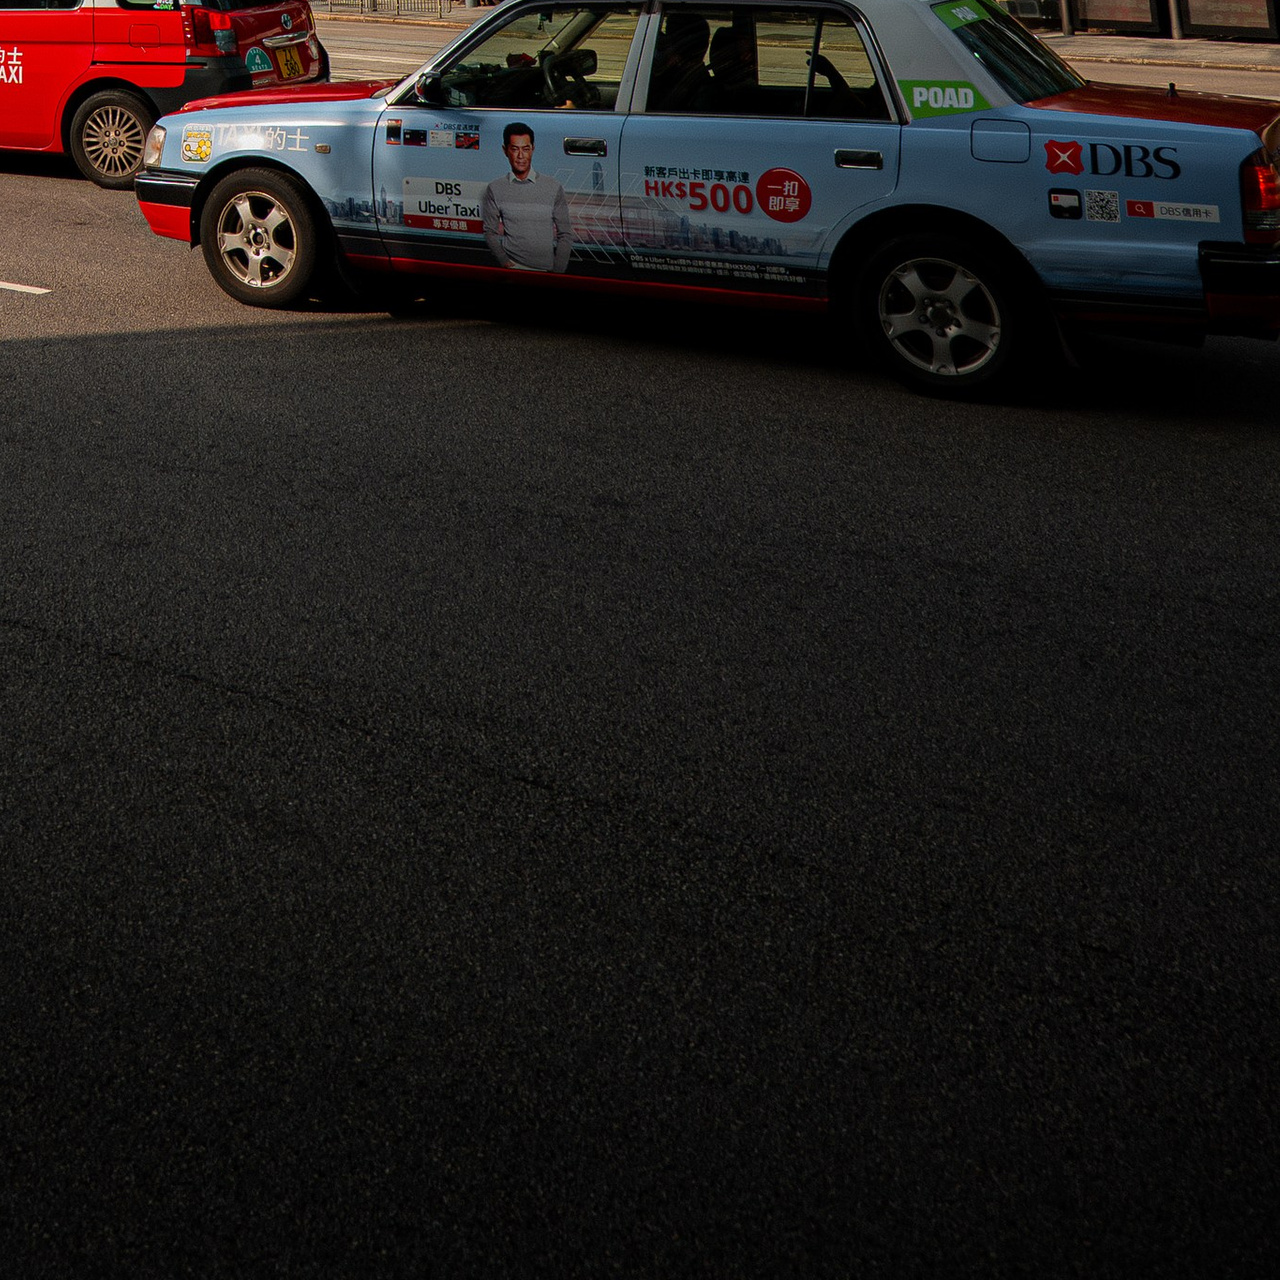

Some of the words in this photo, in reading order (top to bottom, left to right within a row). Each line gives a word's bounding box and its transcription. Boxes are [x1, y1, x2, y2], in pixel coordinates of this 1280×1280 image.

[255, 54, 262, 65] 4
[913, 86, 975, 109] POAD
[266, 126, 310, 152] 的士
[1087, 142, 1182, 180] DBS
[643, 165, 750, 184] 新客戶出卡即享高達
[435, 181, 462, 196] DBS
[644, 179, 754, 215] HK$500
[766, 180, 799, 197] 一扣
[418, 200, 451, 215] Uber
[452, 203, 481, 218] Taxi
[768, 196, 800, 213] 即享
